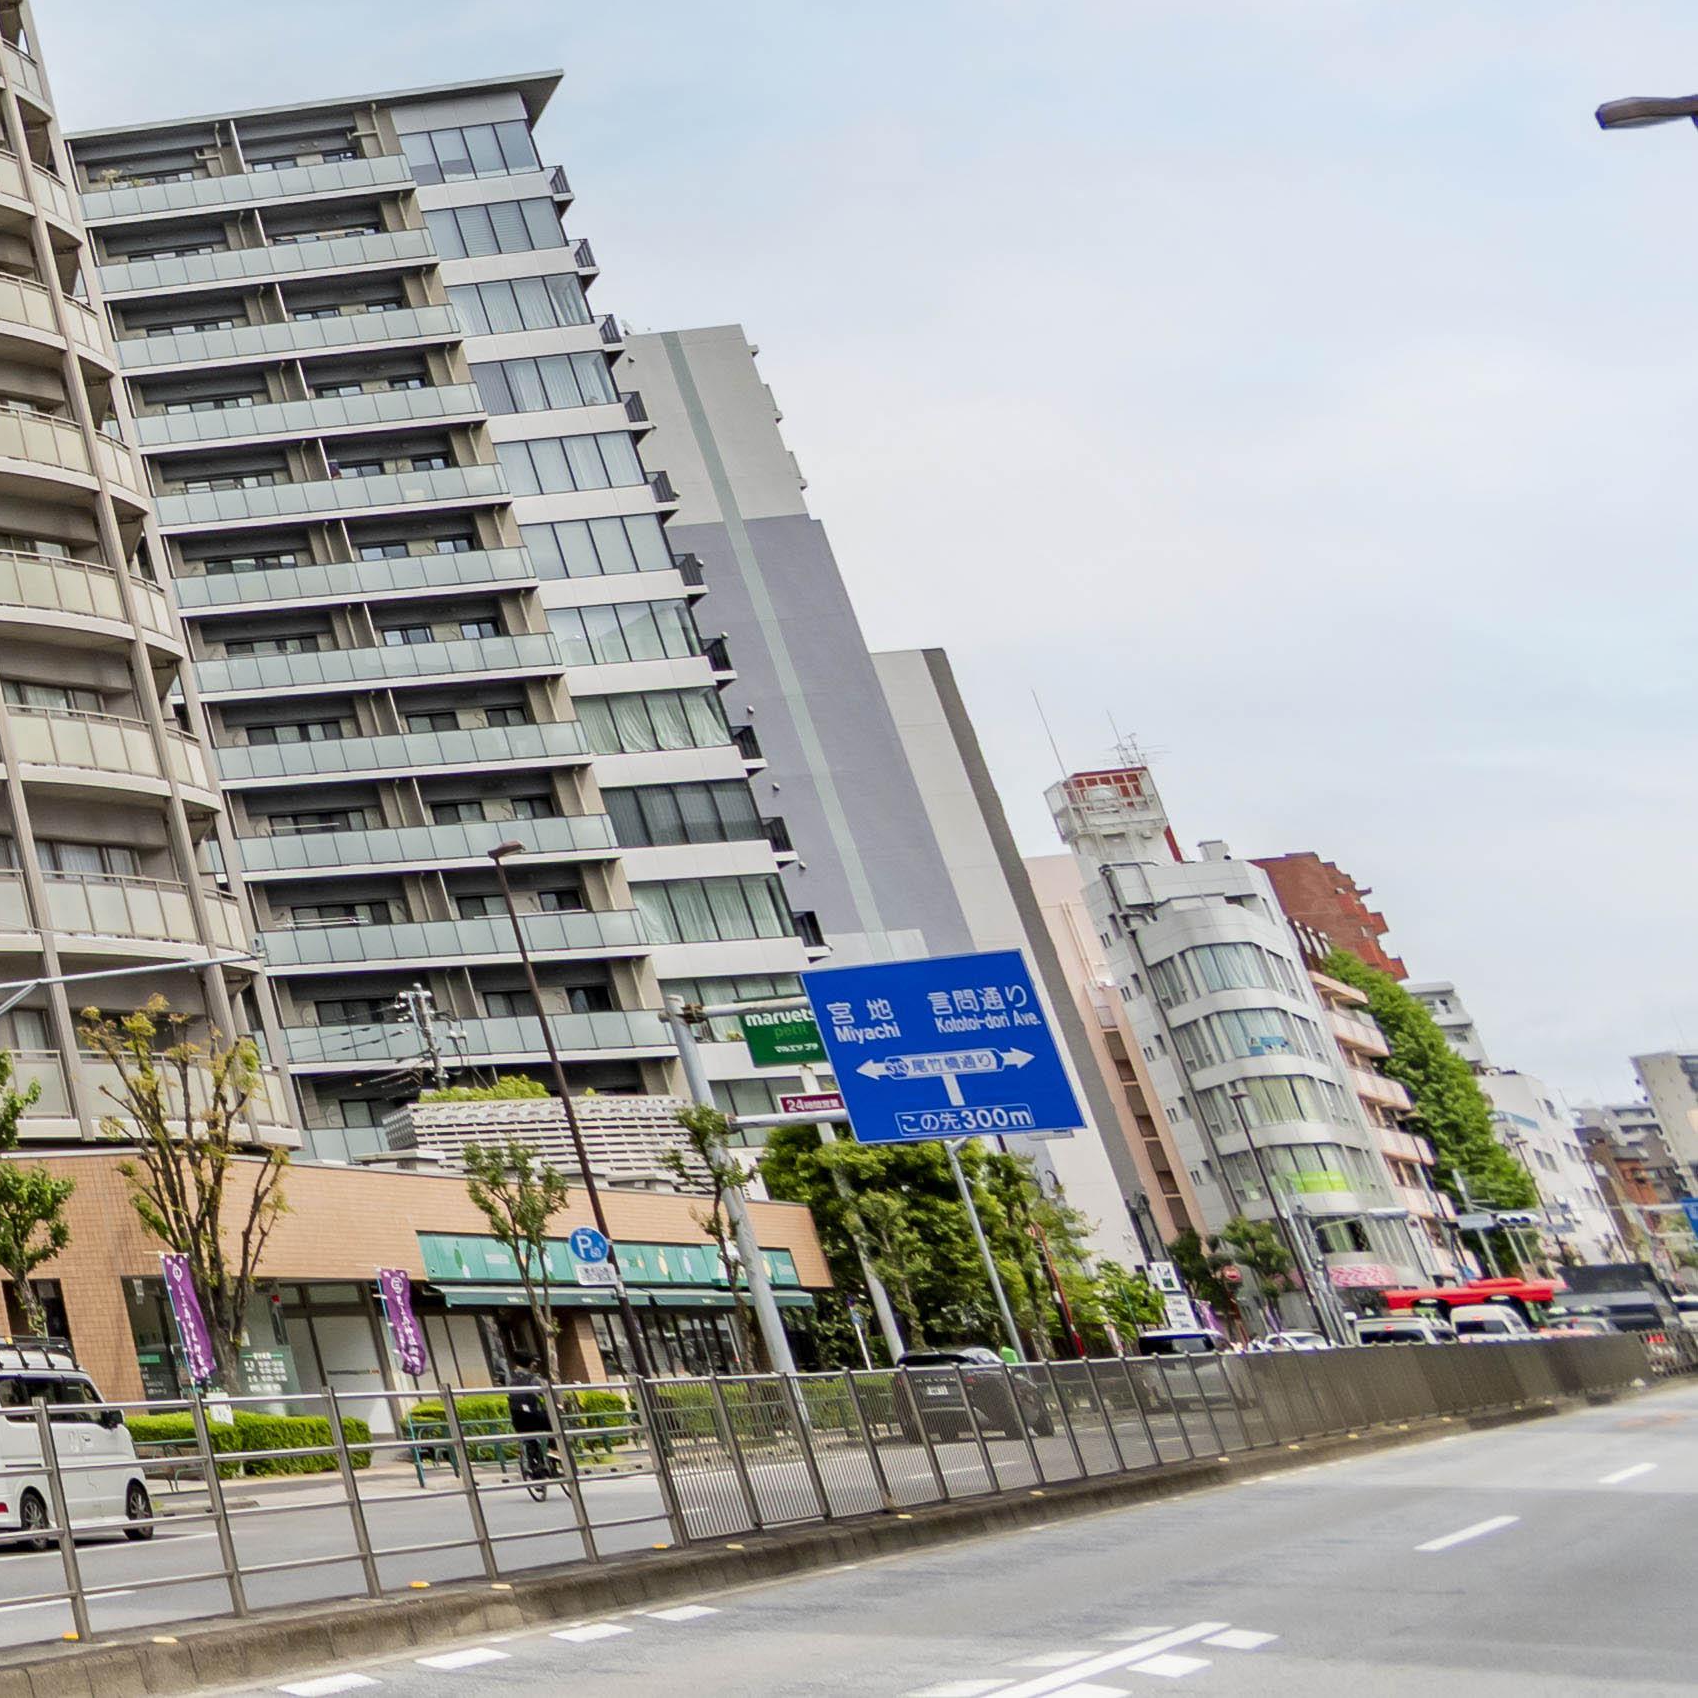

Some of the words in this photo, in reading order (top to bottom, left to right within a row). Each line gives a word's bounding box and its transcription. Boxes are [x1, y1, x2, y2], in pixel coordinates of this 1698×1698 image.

[927, 984, 1028, 1016] 言問通り
[833, 1021, 902, 1045] Miyachi
[934, 1011, 1010, 1034] Kototoi-dori
[1013, 1009, 1042, 1027] Ave.
[901, 1108, 1032, 1133] この先300m
